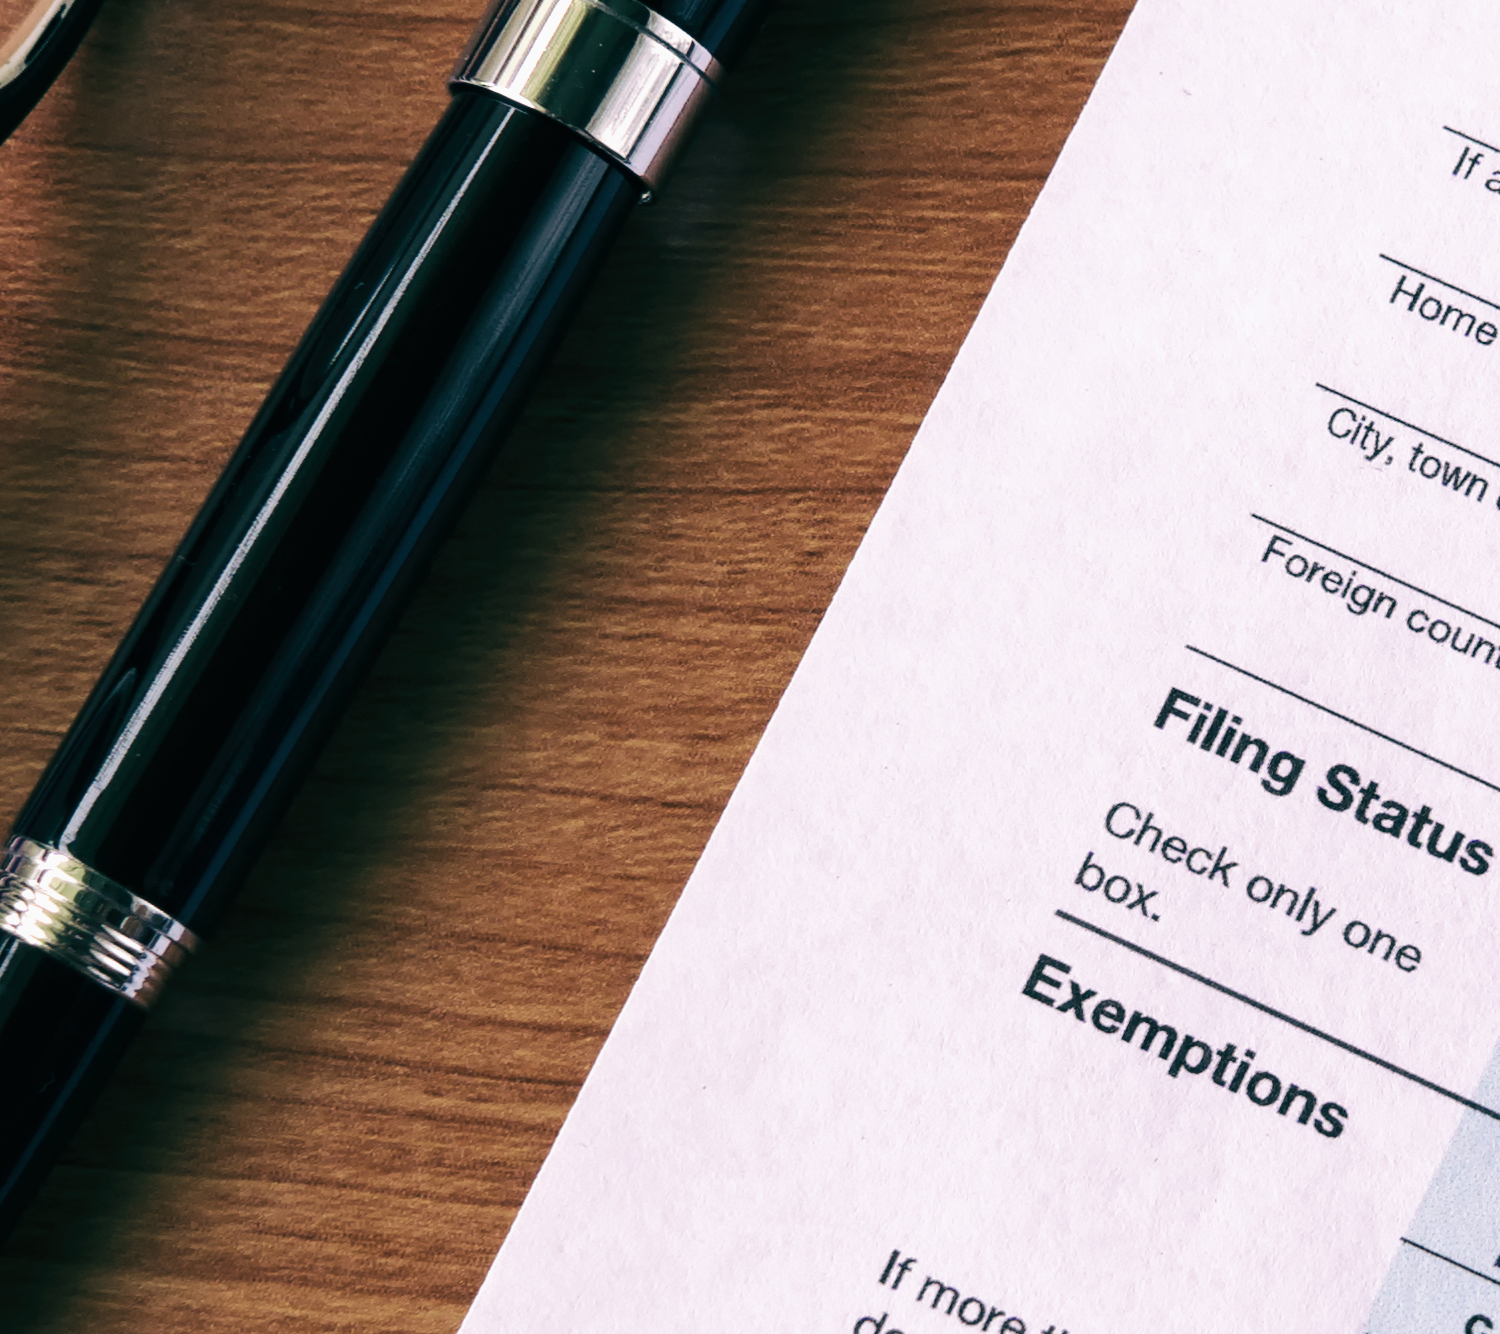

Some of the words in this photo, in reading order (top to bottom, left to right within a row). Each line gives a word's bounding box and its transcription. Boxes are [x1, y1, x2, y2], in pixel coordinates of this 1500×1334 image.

[1451, 145, 1485, 180] If
[1260, 533, 1398, 620] Foreign
[1153, 686, 1307, 798] Filing
[1315, 763, 1495, 877] Status
[1073, 850, 1161, 923] box.
[1104, 801, 1239, 889] Check
[1245, 874, 1338, 937] only
[1341, 919, 1423, 974] one
[1021, 952, 1349, 1140] Exemptions
[877, 1248, 917, 1291] If
